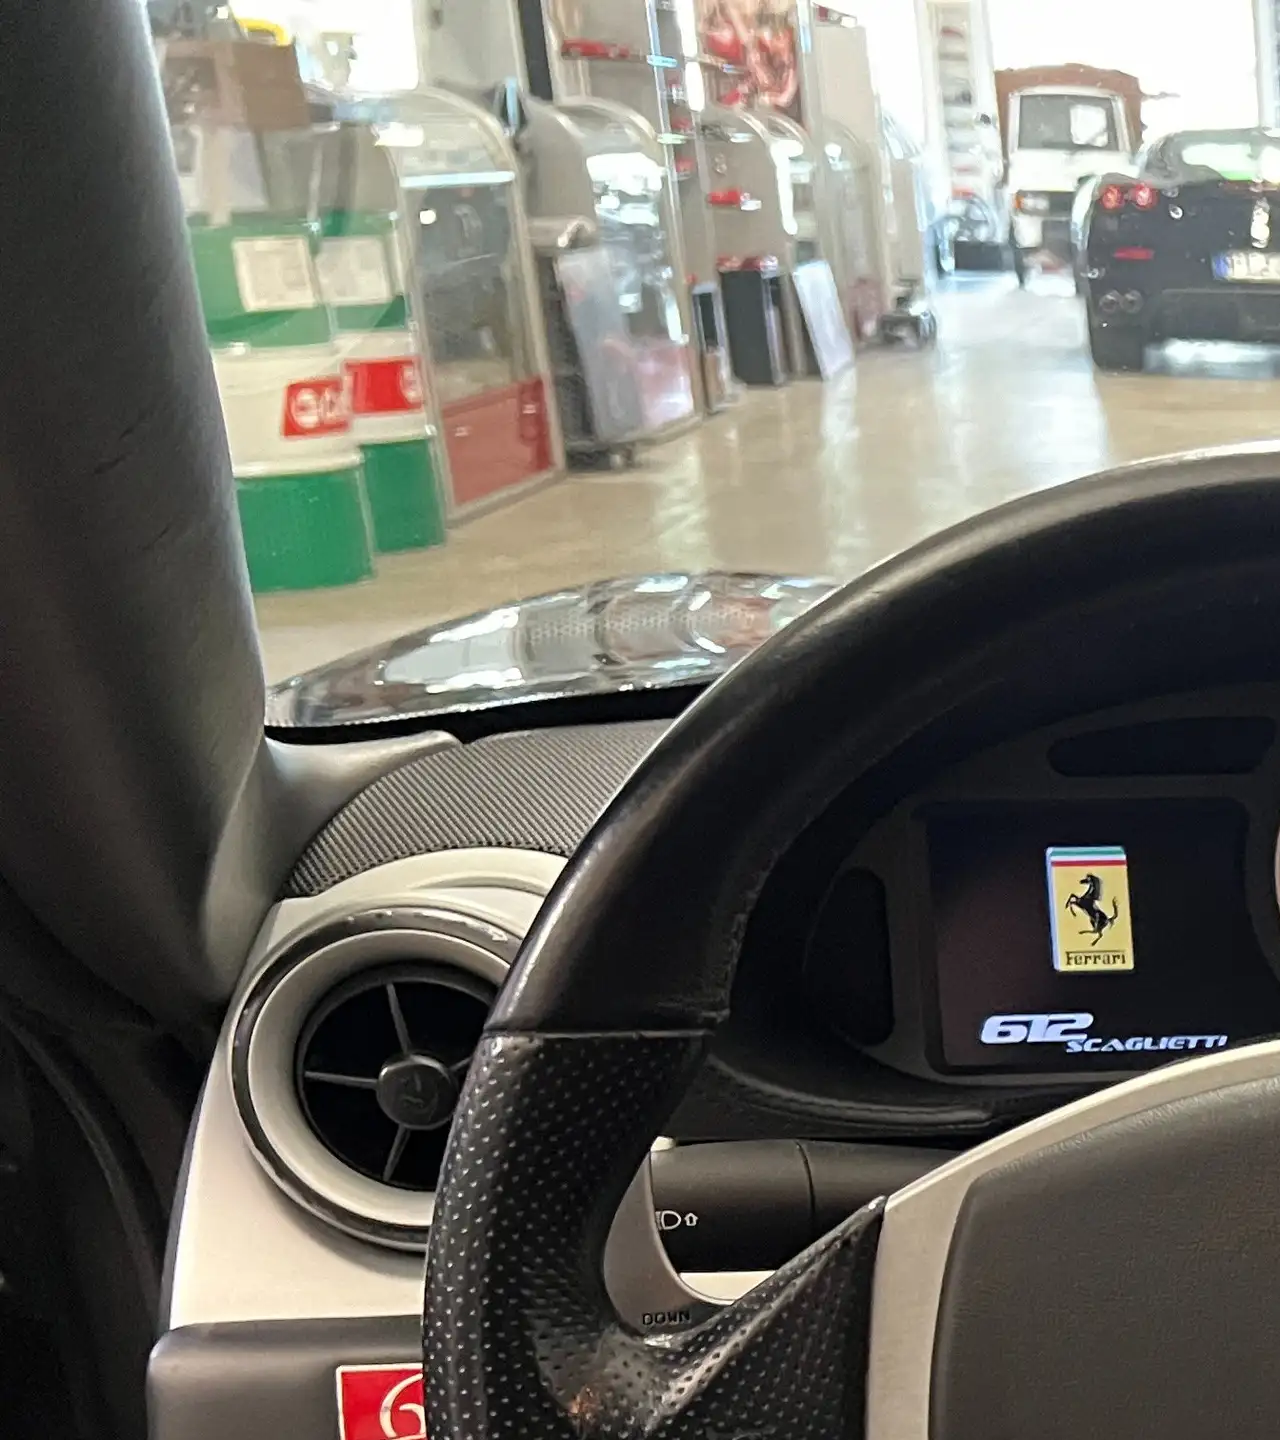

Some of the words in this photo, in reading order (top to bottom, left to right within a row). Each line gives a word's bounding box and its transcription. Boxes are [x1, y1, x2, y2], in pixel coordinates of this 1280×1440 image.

[1065, 950, 1127, 967] Ferrari
[980, 1012, 1094, 1045] 612
[1065, 1034, 1228, 1055] SCAGLIETTI
[641, 1310, 690, 1327] DOWN
